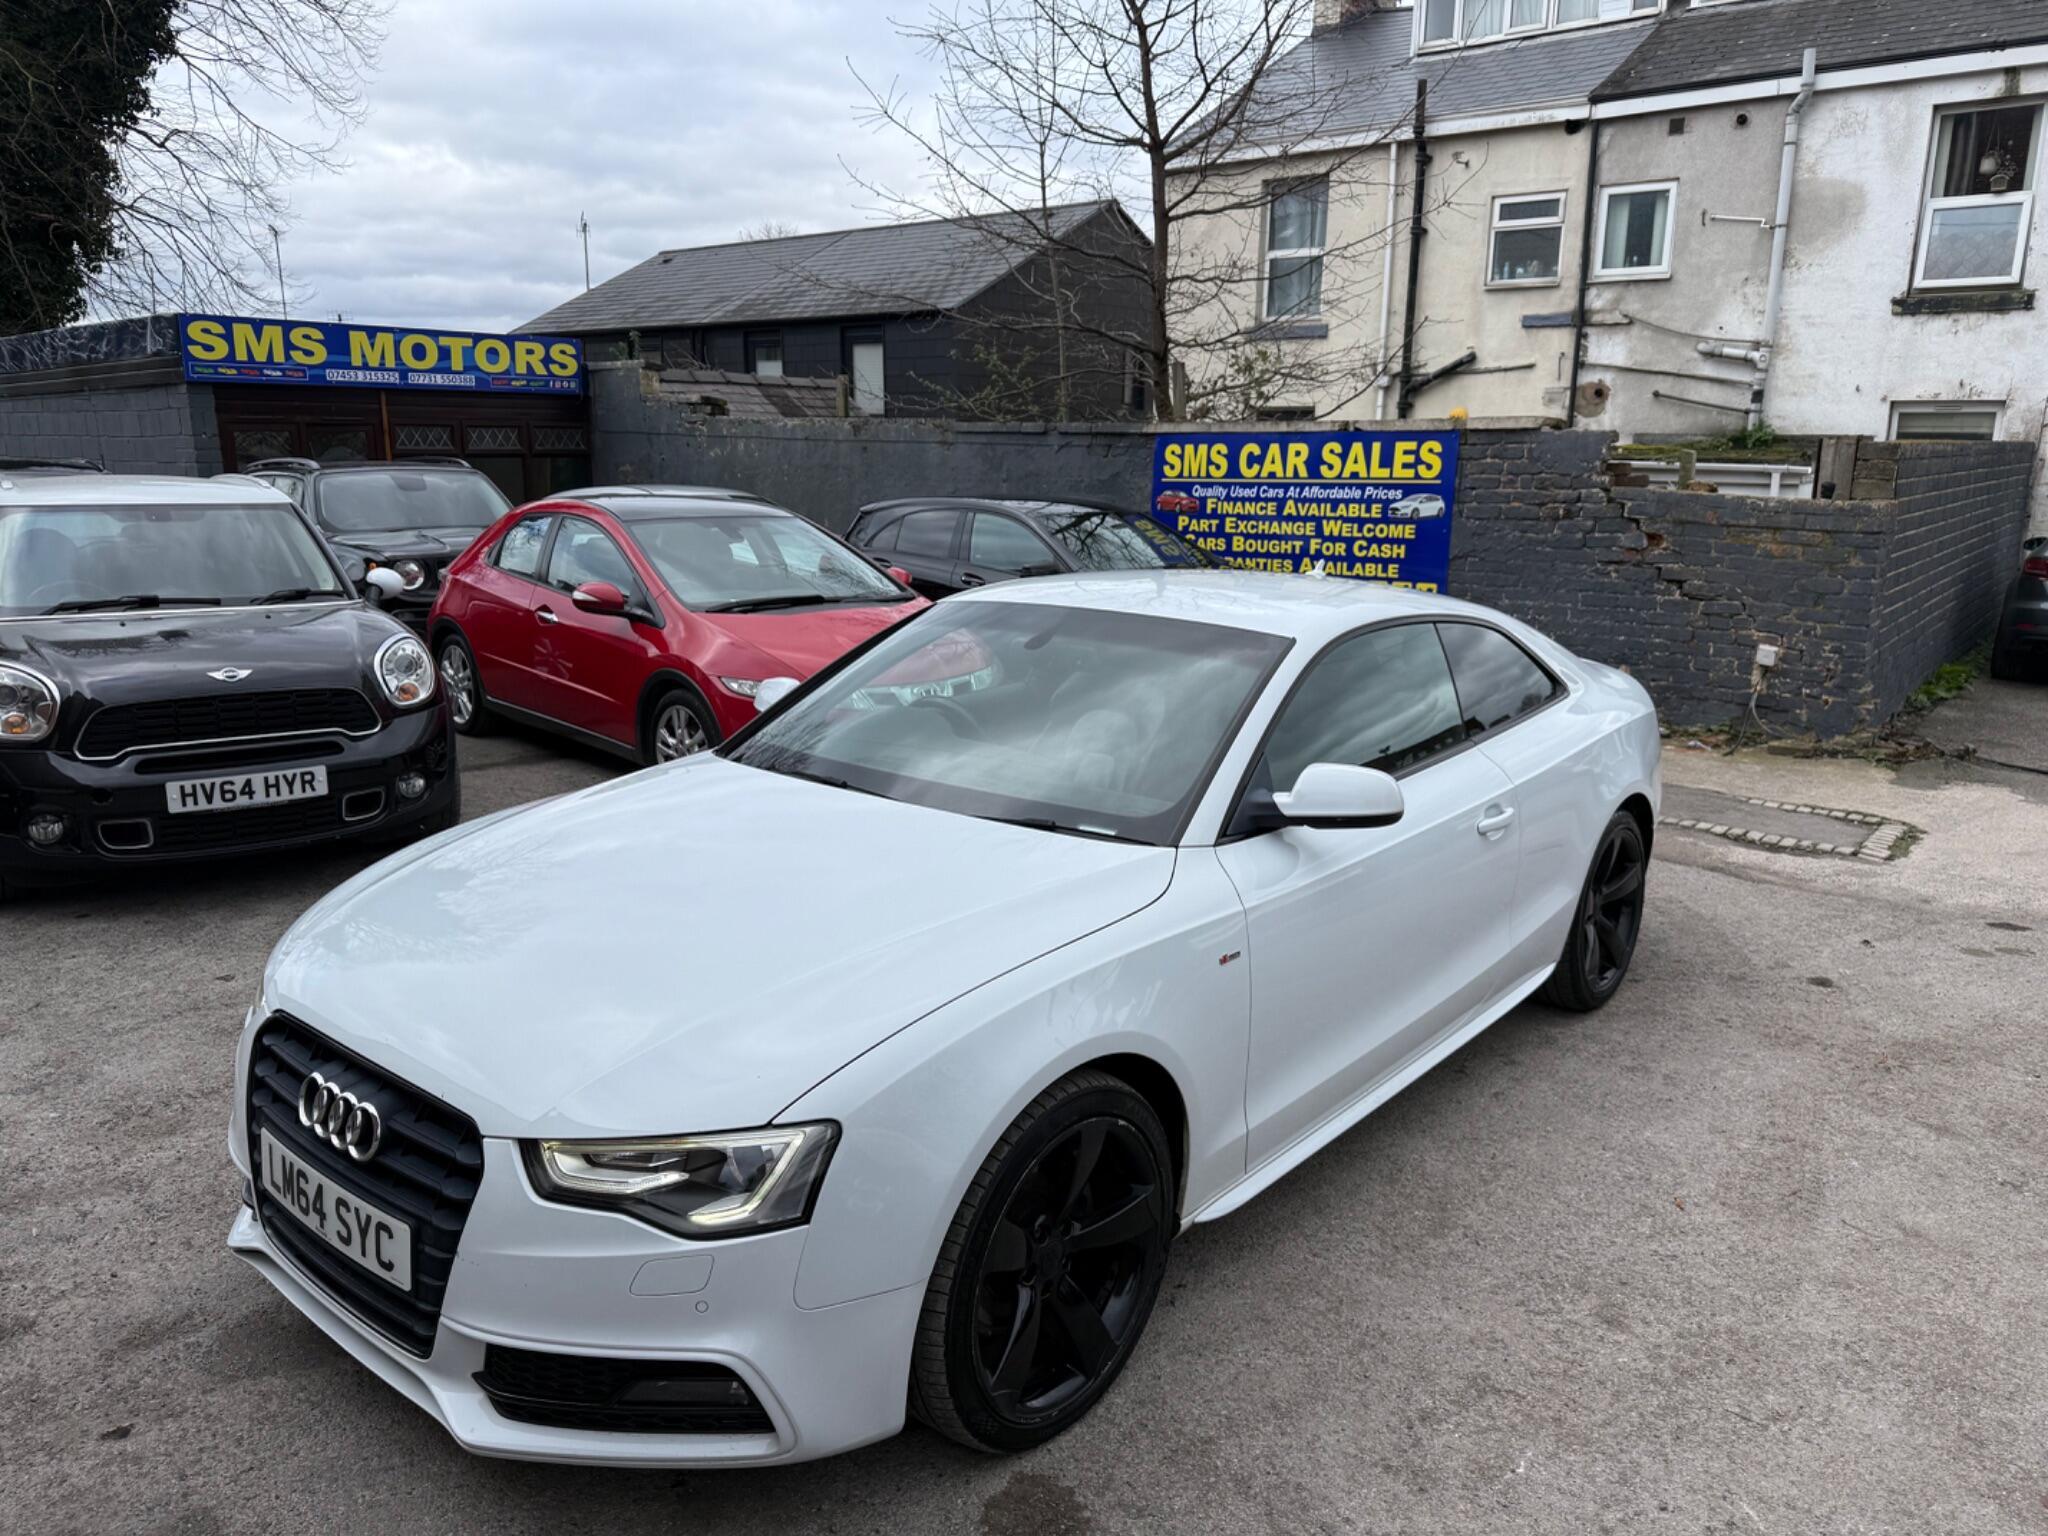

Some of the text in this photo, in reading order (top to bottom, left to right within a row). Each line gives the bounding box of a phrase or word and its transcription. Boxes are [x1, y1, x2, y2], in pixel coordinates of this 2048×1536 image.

[187, 320, 578, 376] SMS MOTORS
[1163, 441, 1443, 479] SMS CAR SALES
[1192, 485, 1403, 500] Quality Used Cars At Affordable Prices
[1206, 498, 1382, 518] FINANCE AVAILABLE
[1178, 516, 1416, 539] PART EXCHANGE WELCOME
[1232, 536, 1303, 554] BOUGHT
[1309, 538, 1347, 556] FOR
[1353, 540, 1406, 559] CASH
[179, 778, 256, 808] HV64
[263, 770, 317, 798] HYR
[268, 1143, 395, 1272] LM64 SYC
